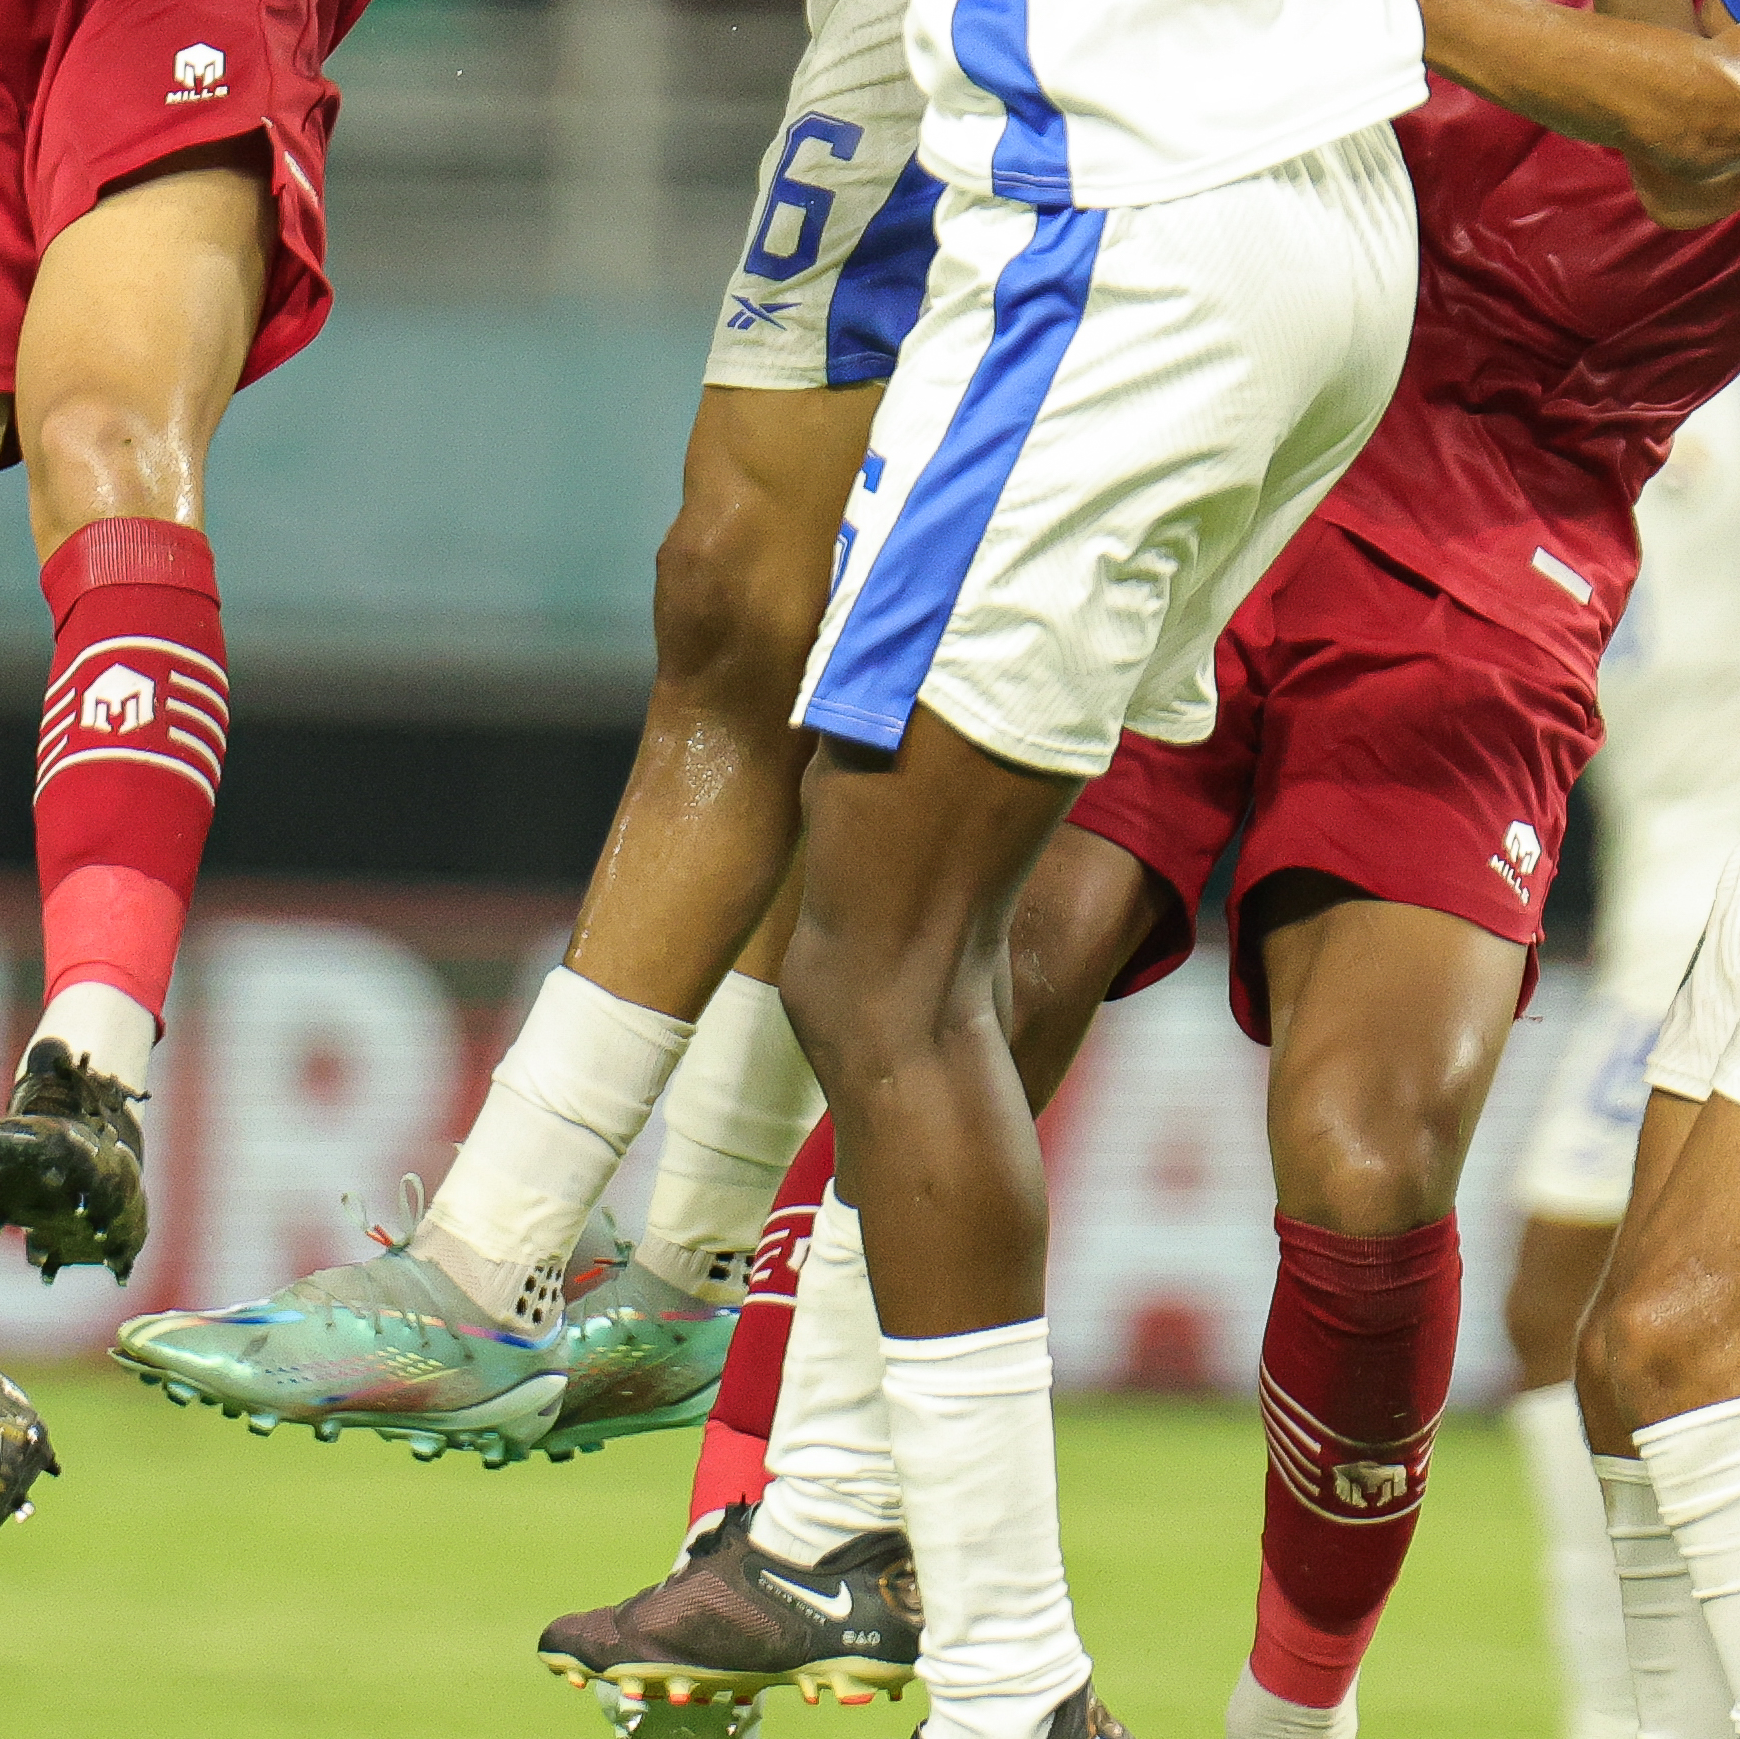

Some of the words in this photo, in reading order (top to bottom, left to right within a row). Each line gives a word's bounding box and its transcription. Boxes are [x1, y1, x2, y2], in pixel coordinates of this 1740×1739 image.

[165, 85, 230, 104] MILLS
[744, 111, 865, 282] 6
[1488, 853, 1530, 907] MILLS
